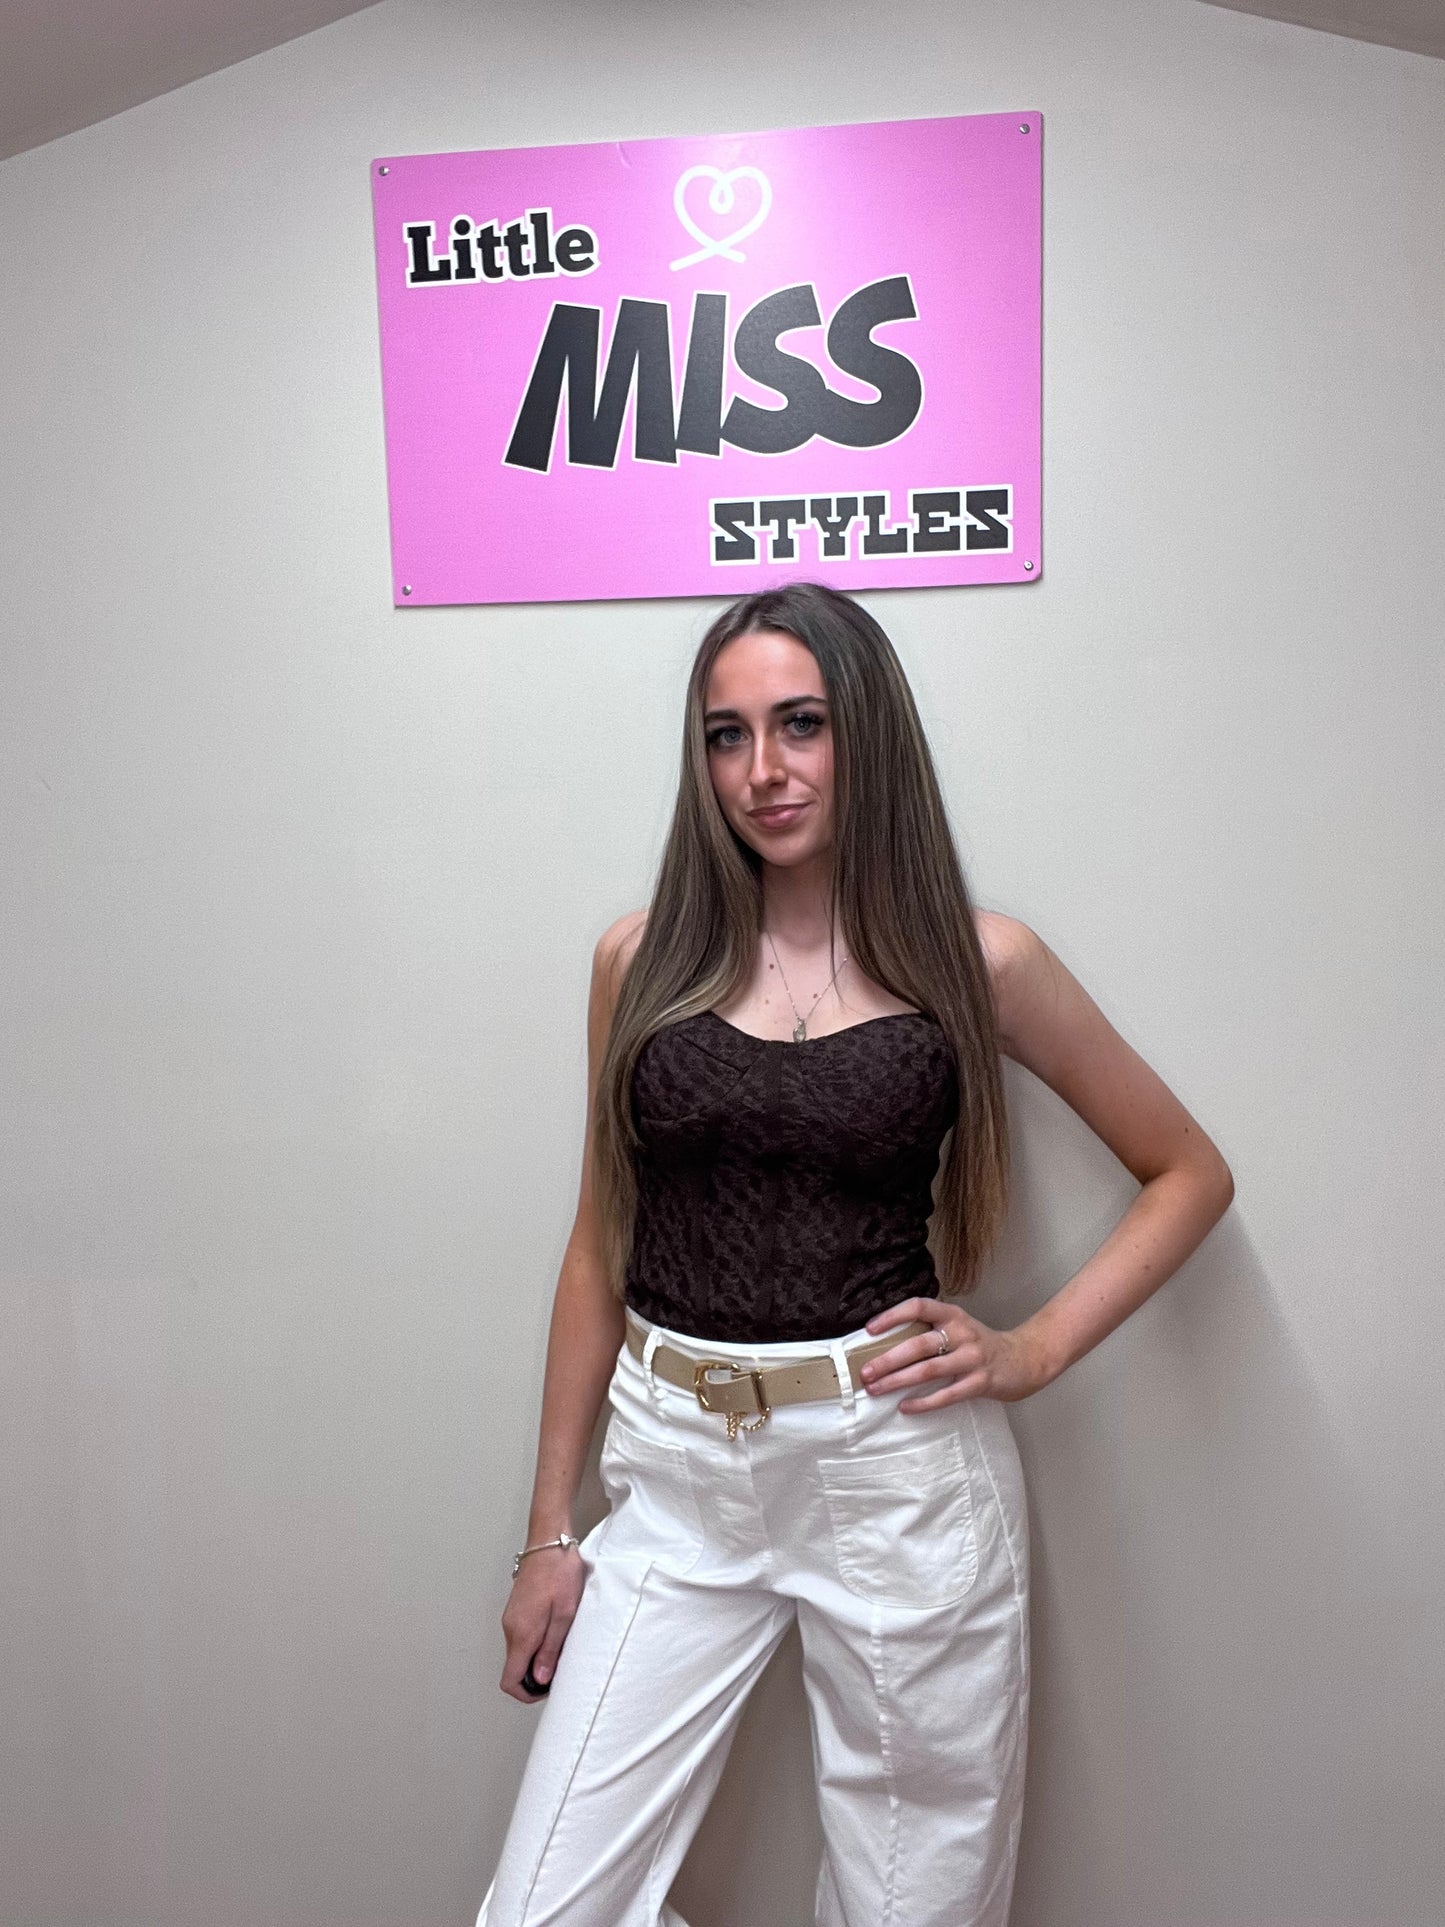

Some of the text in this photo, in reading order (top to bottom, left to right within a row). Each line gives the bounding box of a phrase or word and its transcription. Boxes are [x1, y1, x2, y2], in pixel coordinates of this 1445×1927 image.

[405, 209, 597, 286] Little
[504, 275, 921, 474] MISS
[712, 487, 1010, 563] STYLES
